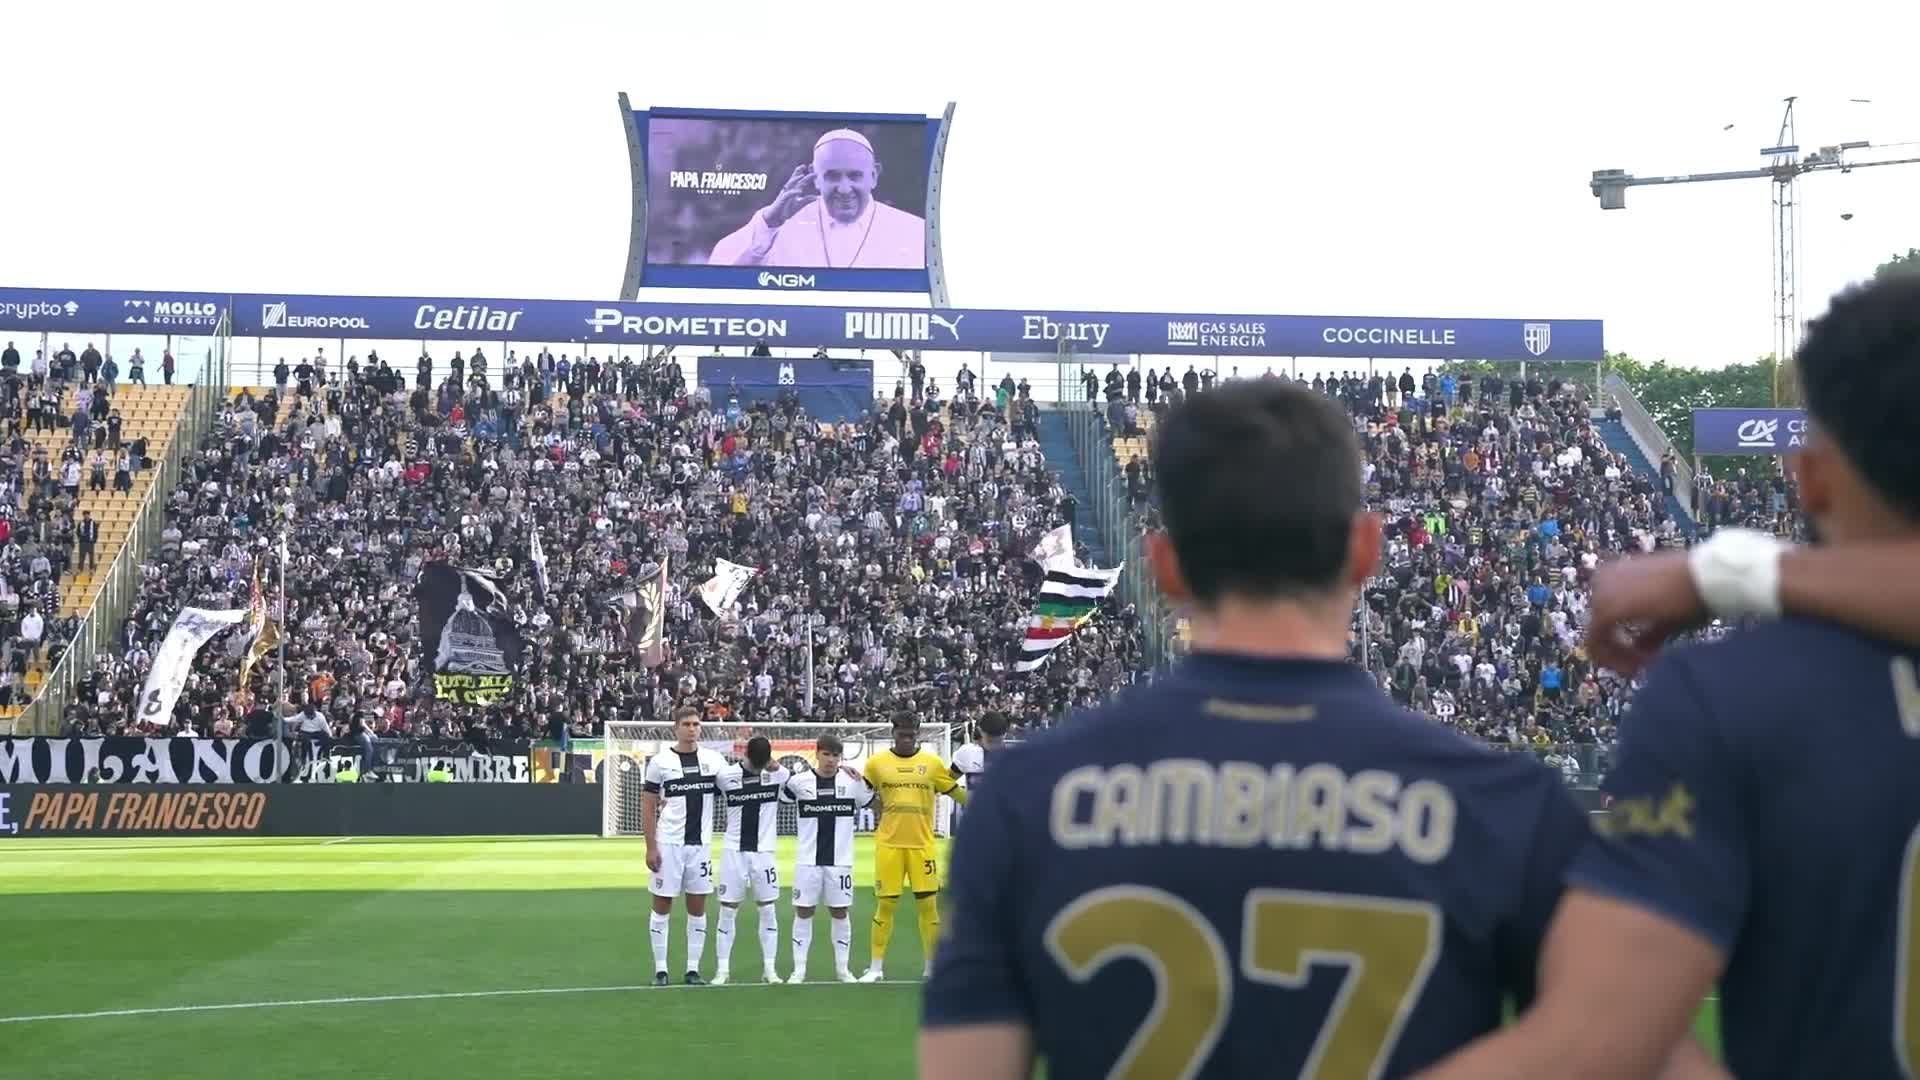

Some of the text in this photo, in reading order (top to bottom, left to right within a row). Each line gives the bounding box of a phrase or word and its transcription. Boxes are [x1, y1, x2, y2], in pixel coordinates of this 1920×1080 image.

[670, 171, 767, 190] PAPA FRANCESCO
[154, 301, 217, 316] MOLLO
[414, 304, 523, 331] Cetilar
[153, 315, 217, 326] NOLEGGIO
[288, 315, 370, 330] EUROPOOL
[585, 308, 787, 337] PROMETEON
[845, 312, 929, 340] PUMA
[1200, 322, 1266, 335] GAS SALES
[1201, 335, 1266, 347] ENERGIA
[1322, 327, 1456, 345] COCCINELLE
[0, 738, 291, 784] MILANO
[24, 792, 98, 830] PAPA
[102, 792, 266, 830] FRANCESCO
[1049, 757, 1457, 865] CAMBIASO
[763, 867, 777, 884] 15
[923, 859, 937, 875] 31
[839, 874, 852, 891] 10
[1044, 884, 1444, 1080] 27
